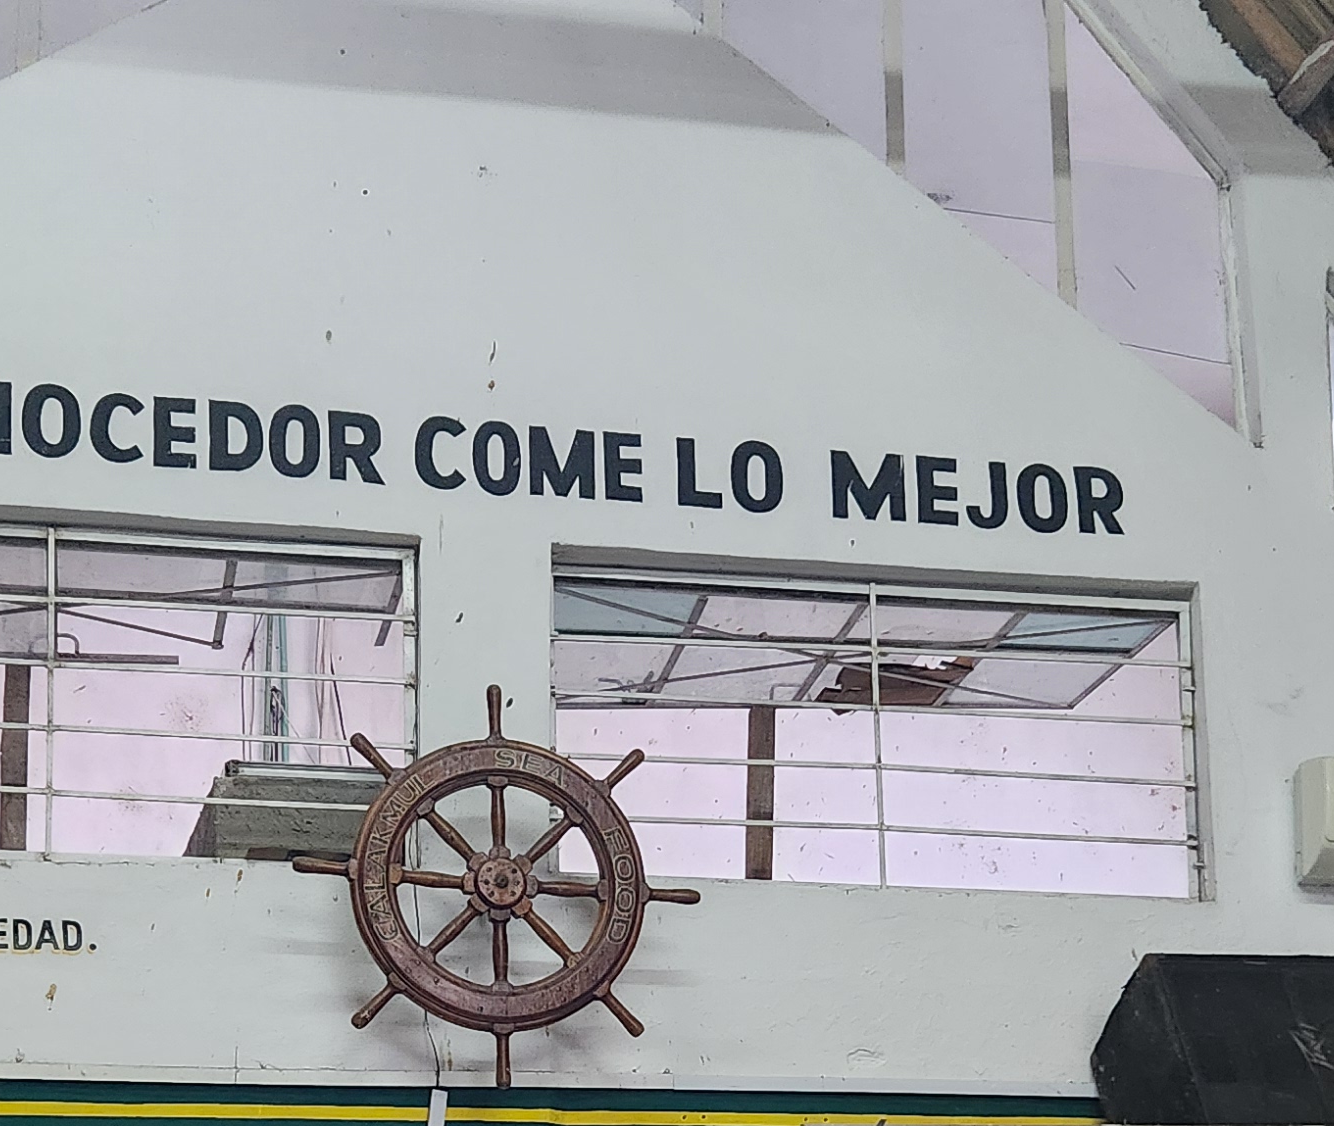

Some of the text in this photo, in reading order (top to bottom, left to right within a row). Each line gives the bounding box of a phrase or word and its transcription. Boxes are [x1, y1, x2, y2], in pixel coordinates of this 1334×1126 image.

[415, 415, 643, 503] COME
[675, 437, 784, 513] LO
[830, 450, 1125, 535] MEJOR
[494, 749, 566, 787] SEA
[365, 774, 435, 941] CALAKMUL
[602, 826, 636, 944] FOOD
